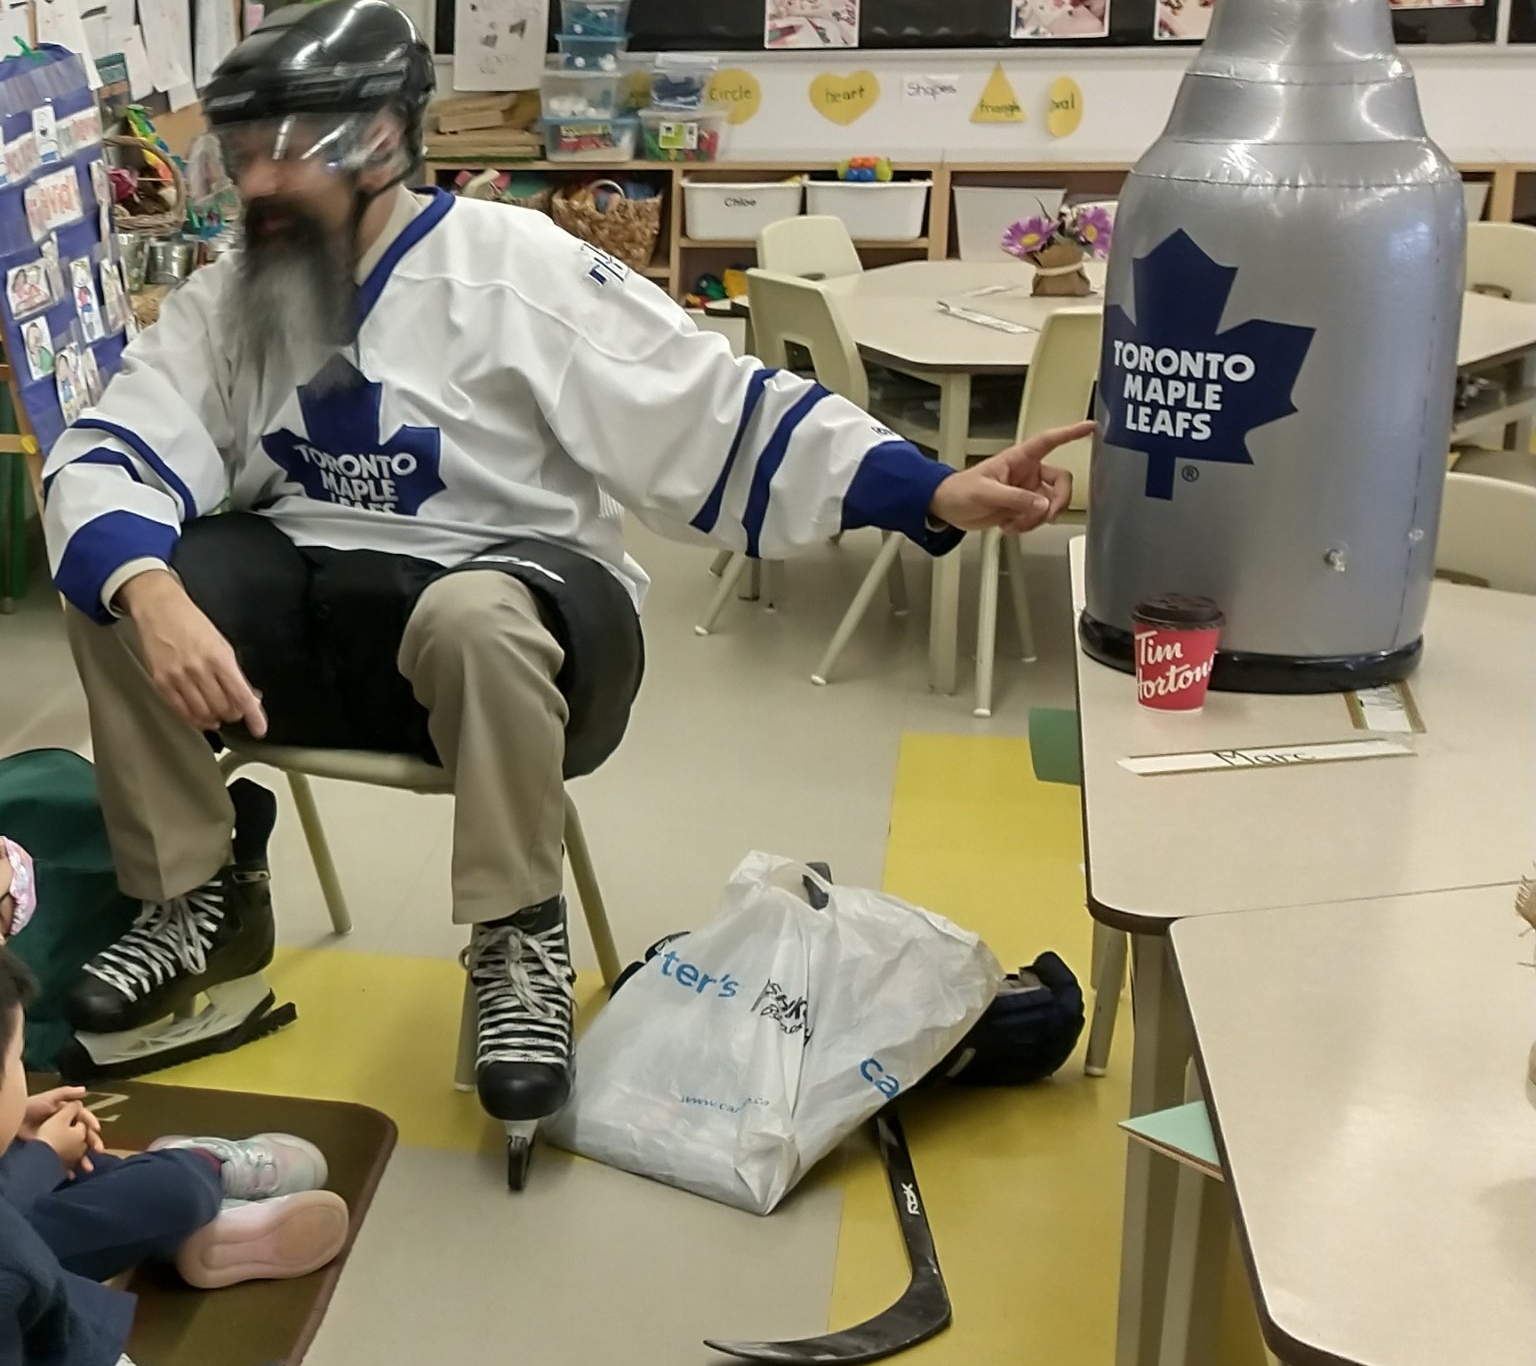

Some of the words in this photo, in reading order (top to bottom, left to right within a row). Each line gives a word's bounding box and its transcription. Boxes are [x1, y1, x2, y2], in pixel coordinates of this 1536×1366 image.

[1113, 339, 1257, 383] TORONTO
[1122, 372, 1224, 412] MAPLE
[1125, 402, 1213, 441] LEAFS
[292, 444, 418, 479] TORONTO
[320, 468, 400, 503] MAPLE
[1135, 629, 1184, 666] Tim
[1213, 749, 1316, 767] Marc
